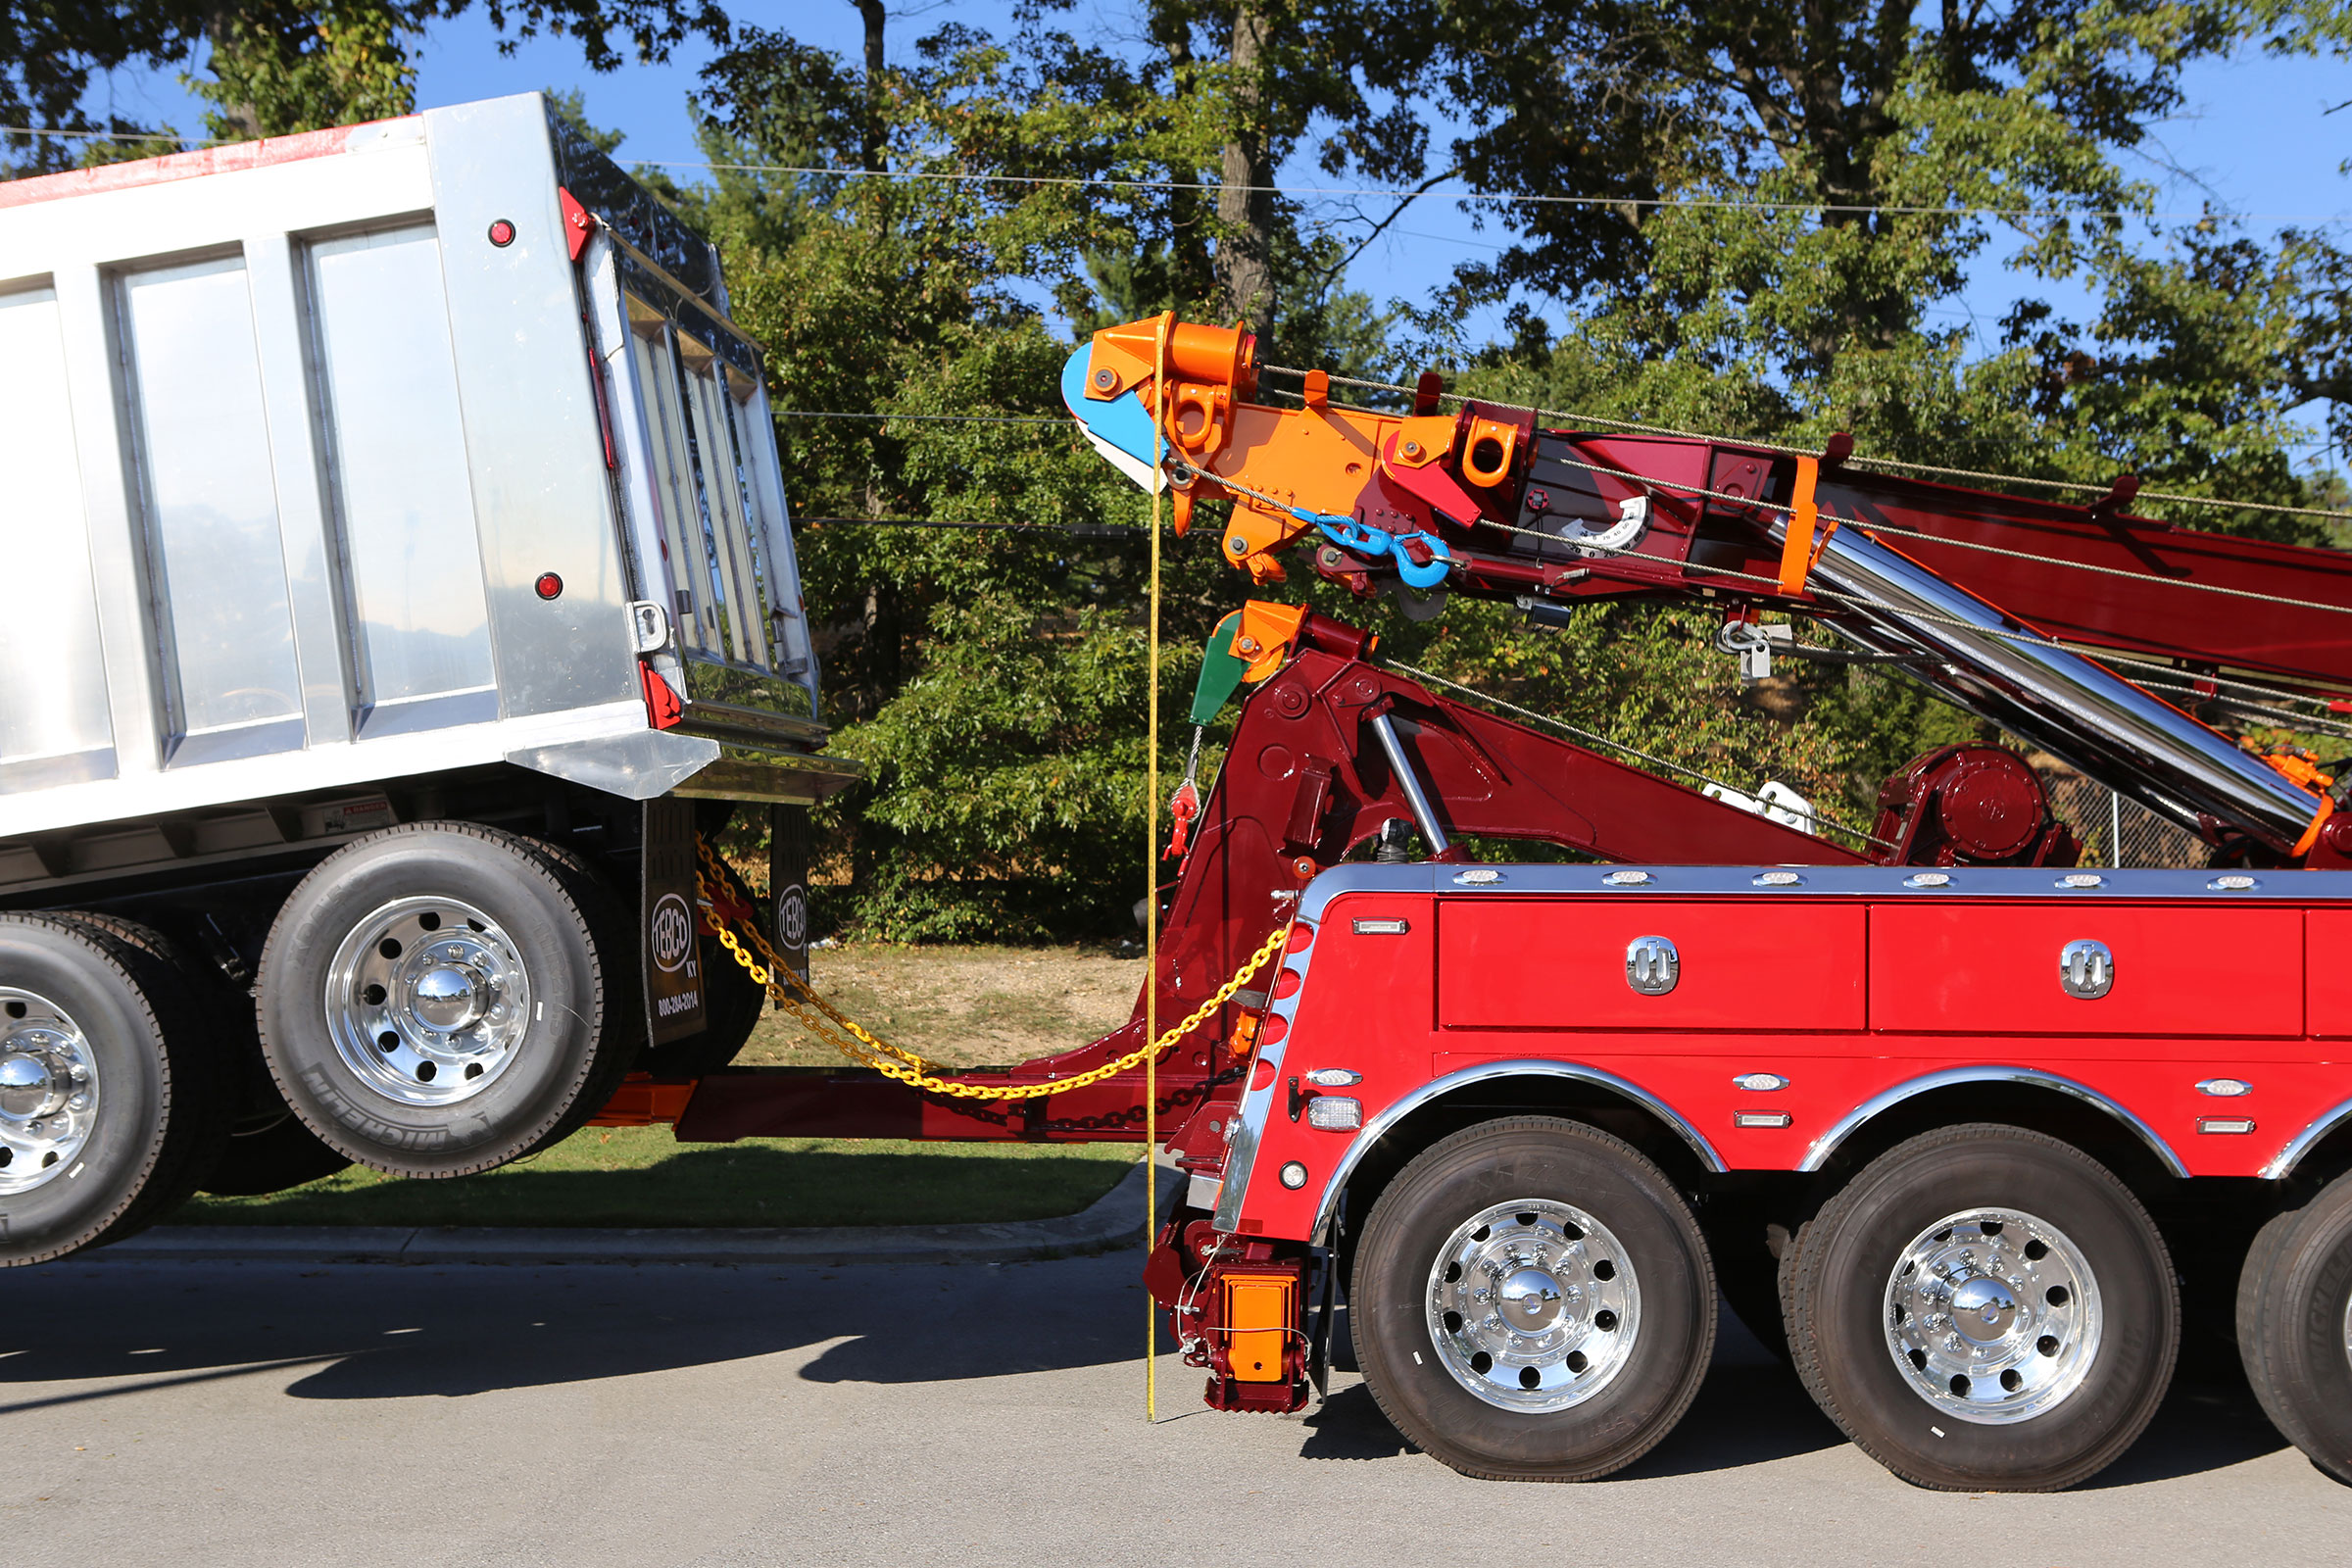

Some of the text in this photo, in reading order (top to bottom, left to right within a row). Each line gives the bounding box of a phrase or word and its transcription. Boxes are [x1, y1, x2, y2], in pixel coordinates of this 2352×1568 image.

[654, 907, 687, 960] TEBCO
[686, 960, 697, 978] KY
[301, 1072, 448, 1151] MICHELIN
